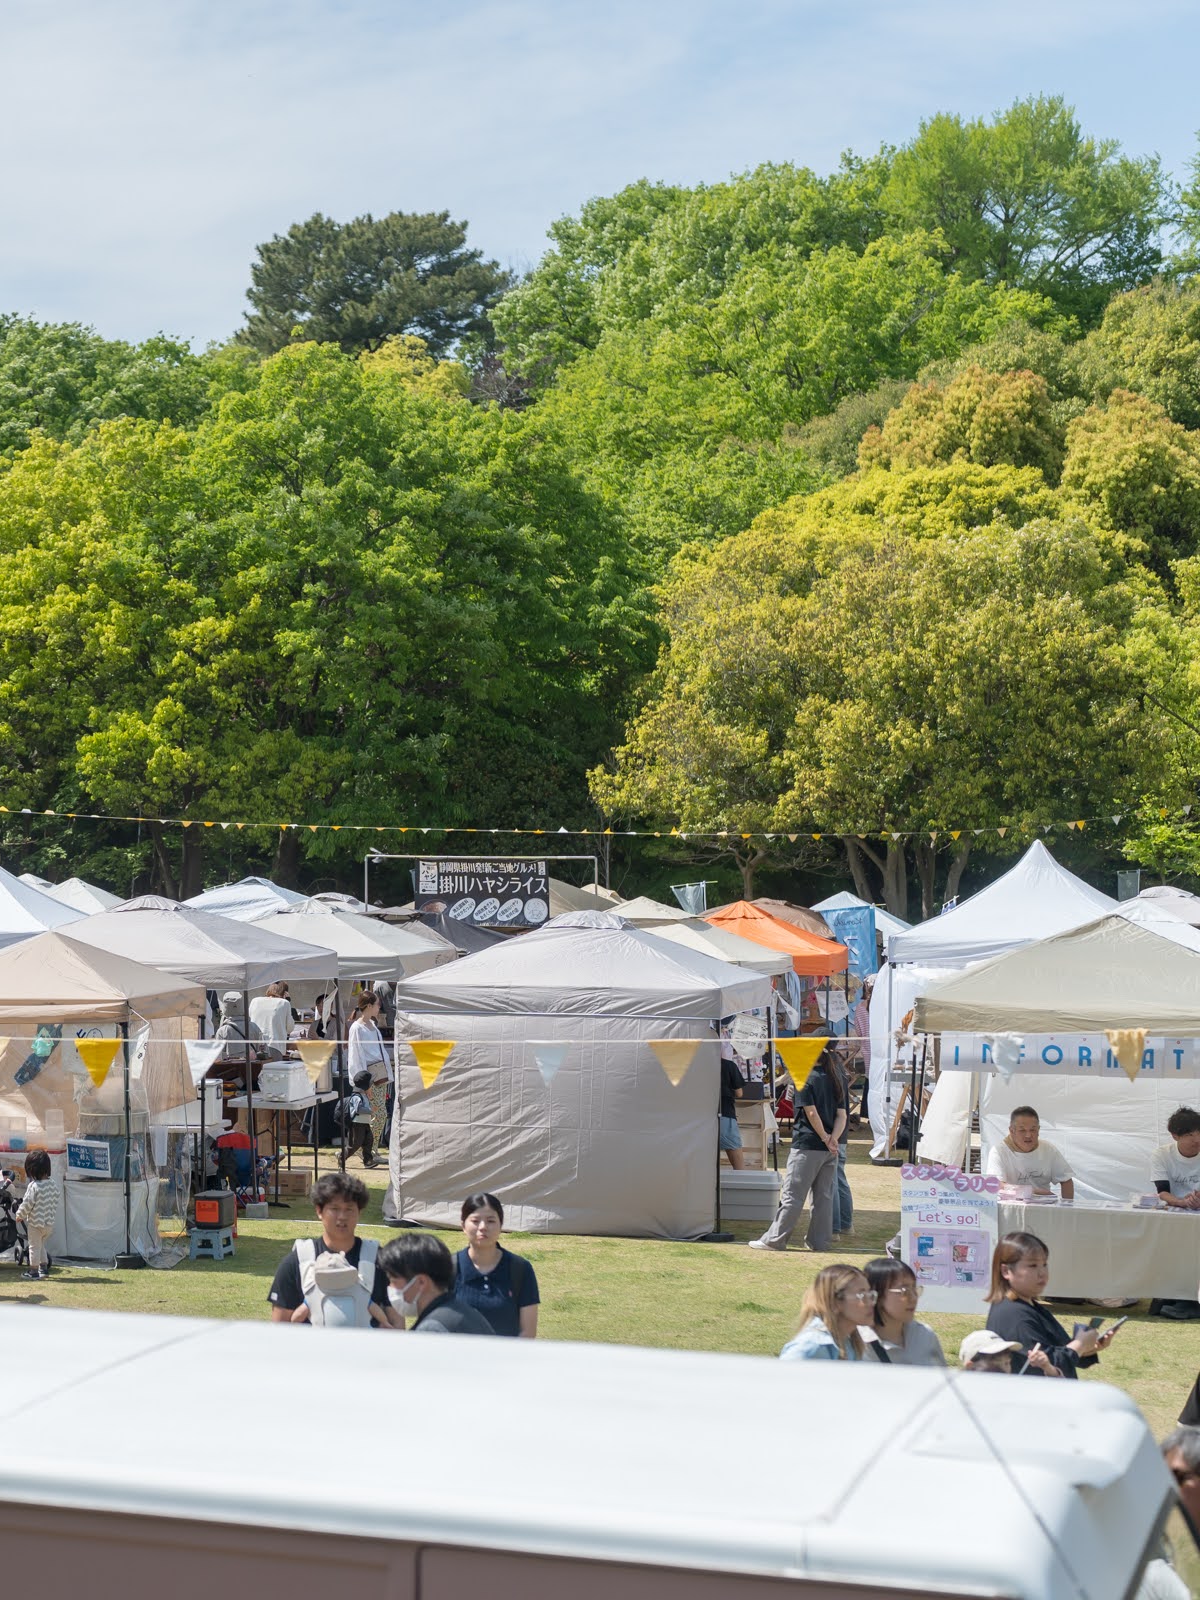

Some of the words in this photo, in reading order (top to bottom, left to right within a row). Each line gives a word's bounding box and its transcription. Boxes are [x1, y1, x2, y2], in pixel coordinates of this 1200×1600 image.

[439, 875, 547, 895] 掛川ハヤシライス
[918, 1210, 952, 1224] Let's
[956, 1213, 978, 1225] go!
